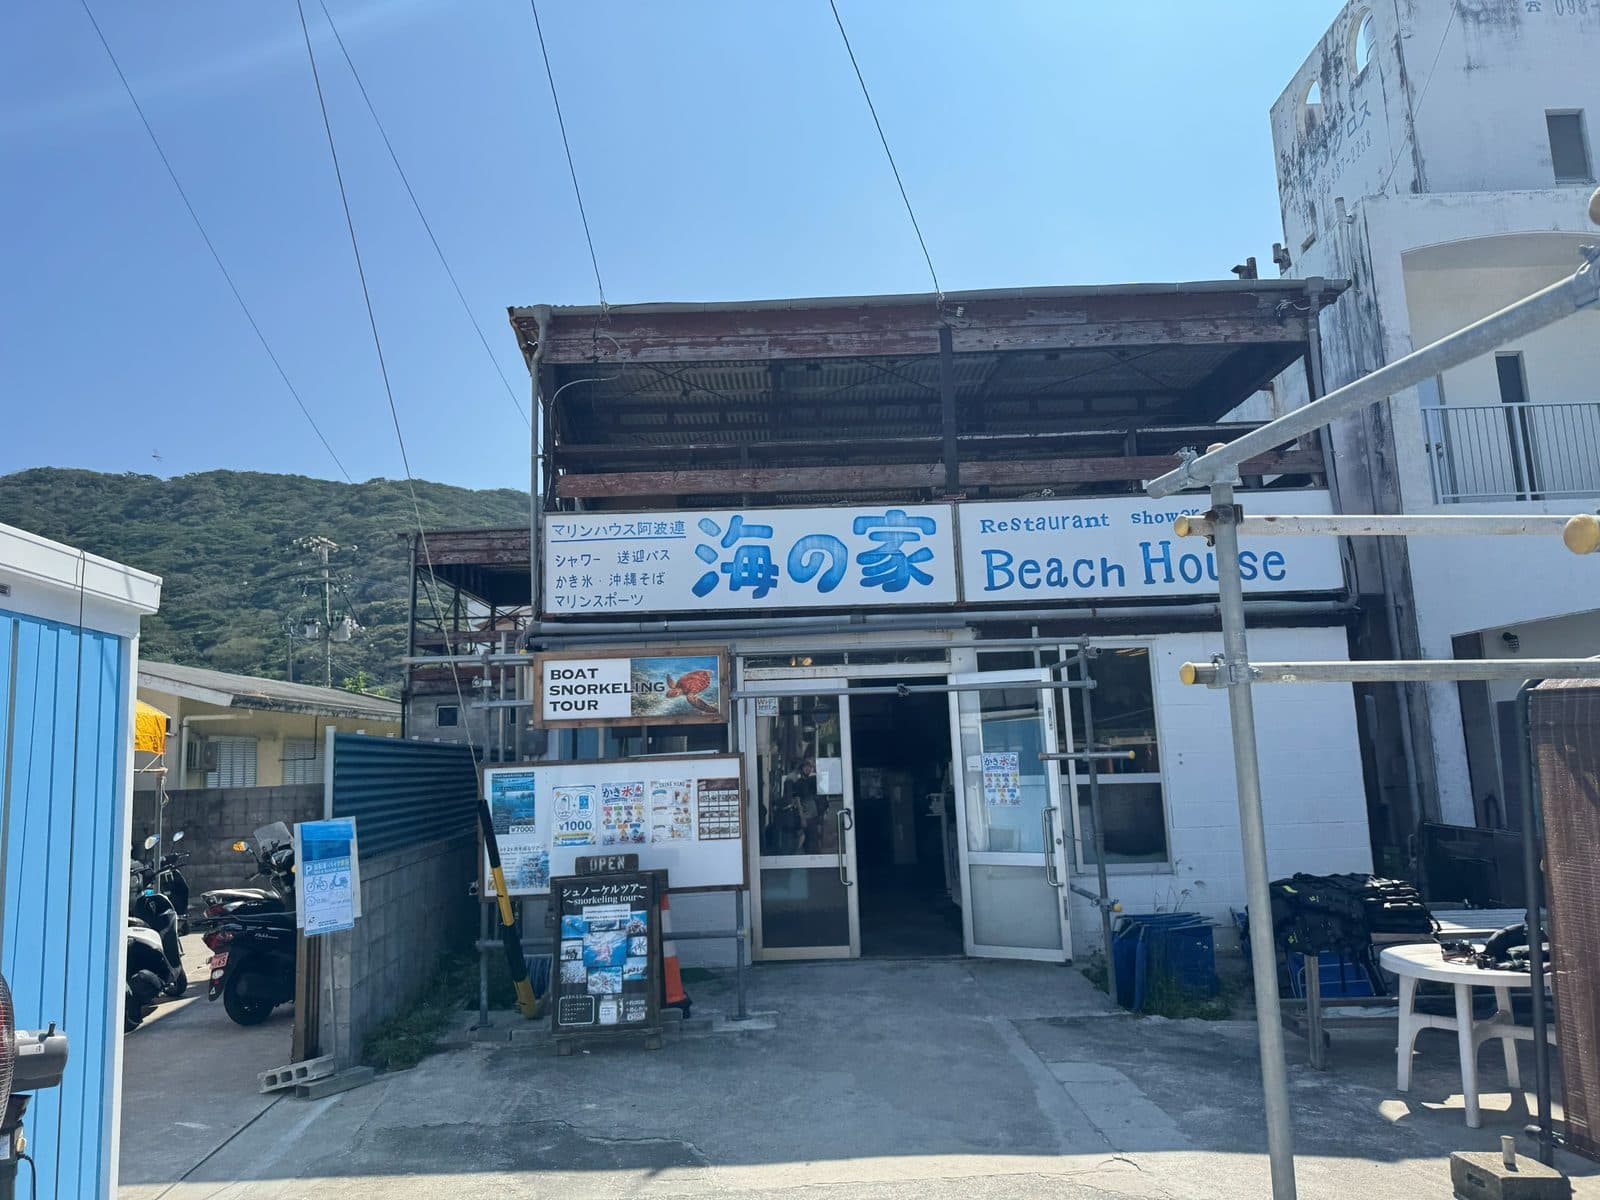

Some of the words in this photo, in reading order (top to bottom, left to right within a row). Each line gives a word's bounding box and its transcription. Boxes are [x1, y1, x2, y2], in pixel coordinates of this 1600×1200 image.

[551, 520, 686, 538] マリンハウス阿波連
[980, 512, 1110, 533] Restaurant
[555, 553, 601, 568] シャワー
[617, 548, 671, 565] 送迎バス
[692, 509, 936, 599] 海の家
[981, 549, 1126, 591] Beach
[554, 591, 644, 608] マリンスポーツ
[550, 668, 599, 680] BOAT
[549, 681, 666, 696] SNORKELING
[549, 700, 599, 712] TOUR
[589, 855, 625, 872] OPEN
[562, 883, 648, 898] シュノーケルツアー
